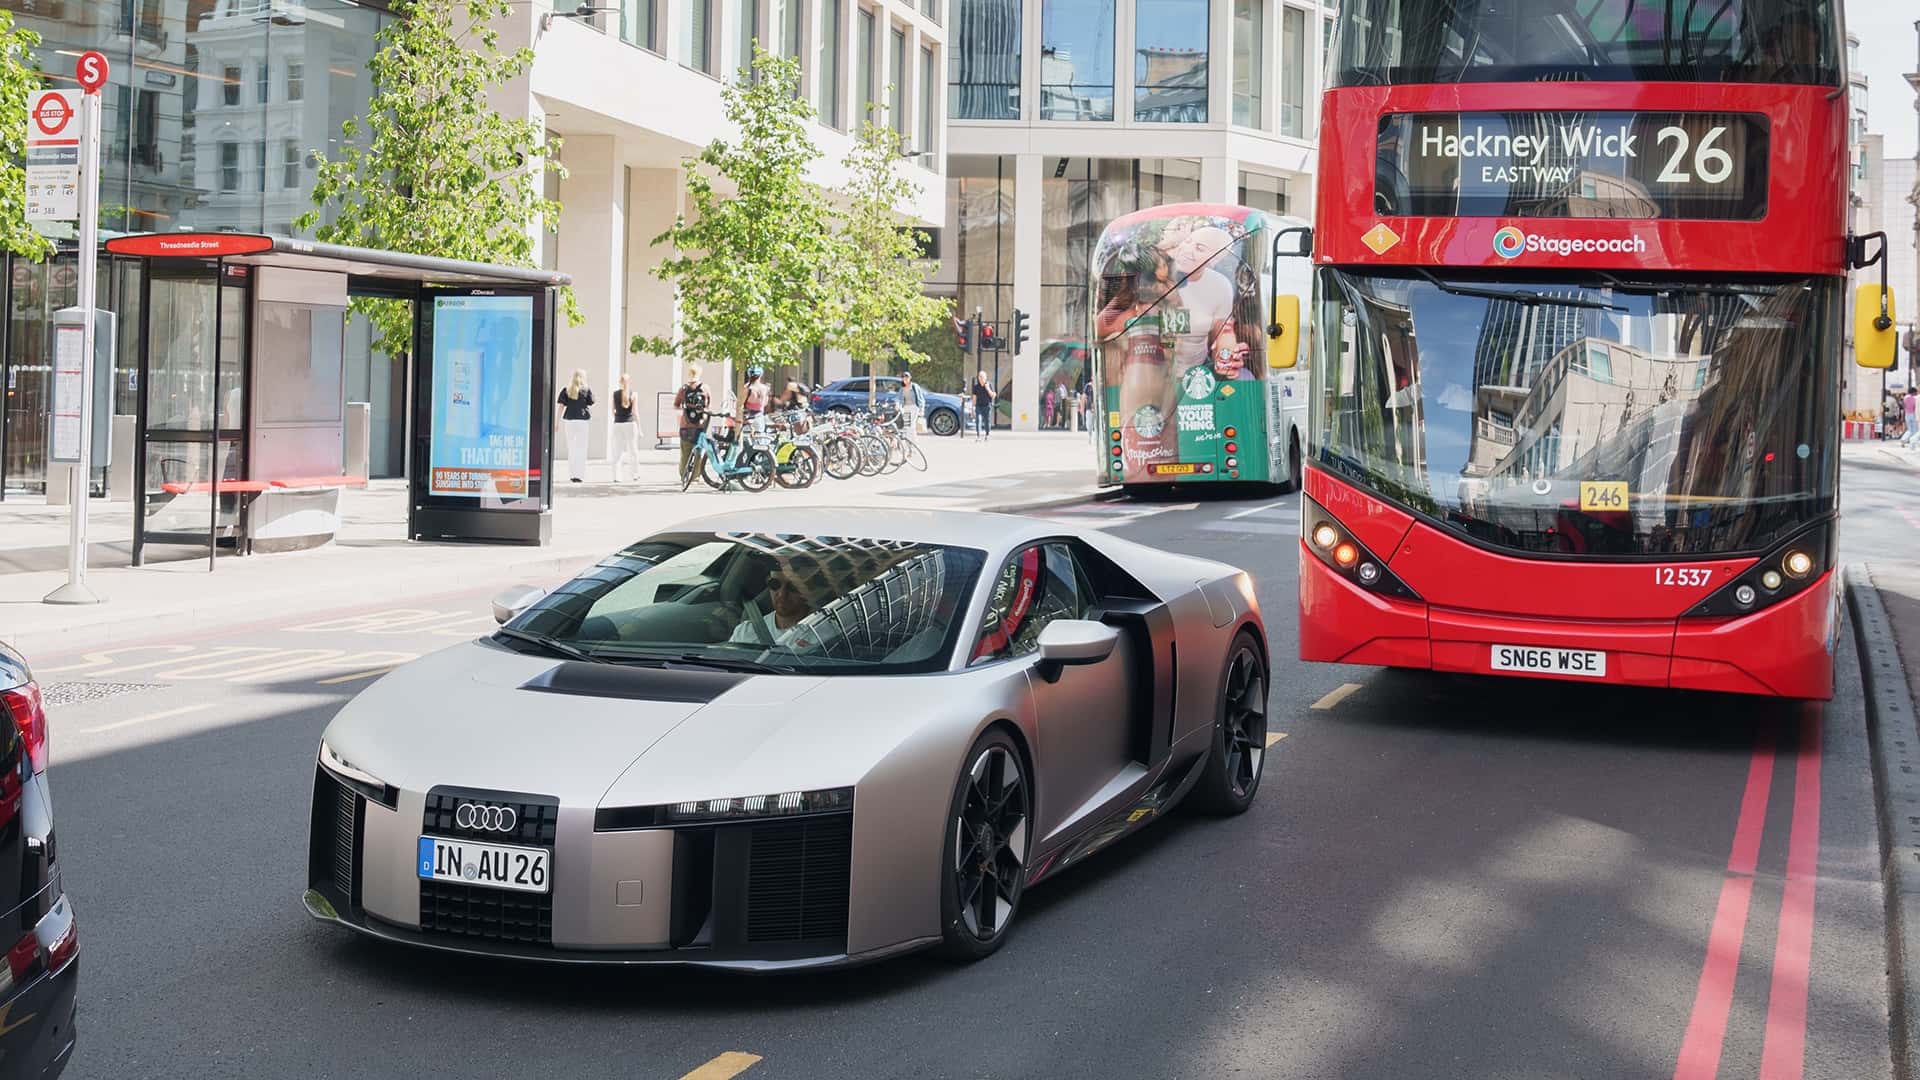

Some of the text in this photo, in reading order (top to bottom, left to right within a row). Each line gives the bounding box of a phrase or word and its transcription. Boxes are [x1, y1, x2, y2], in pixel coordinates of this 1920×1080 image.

[84, 57, 99, 83] S
[39, 109, 65, 118] BUS STOP
[1422, 125, 1637, 165] Hackney Wick
[1656, 126, 1733, 184] 26
[1482, 166, 1573, 183] EASTWAY
[160, 241, 199, 249] Threadneedle
[1526, 234, 1646, 256] Stagecoach
[1178, 410, 1214, 421] YOUR
[1178, 421, 1215, 431] THING.
[461, 448, 522, 465] THAT ONE!
[444, 472, 460, 480] YEARS
[461, 472, 468, 480] OF
[462, 480, 474, 488] INTO
[1587, 487, 1621, 506] 246
[1656, 568, 1712, 586] 12537
[1500, 649, 1597, 671] SN66 WSE
[435, 845, 545, 886] IN AU 26
